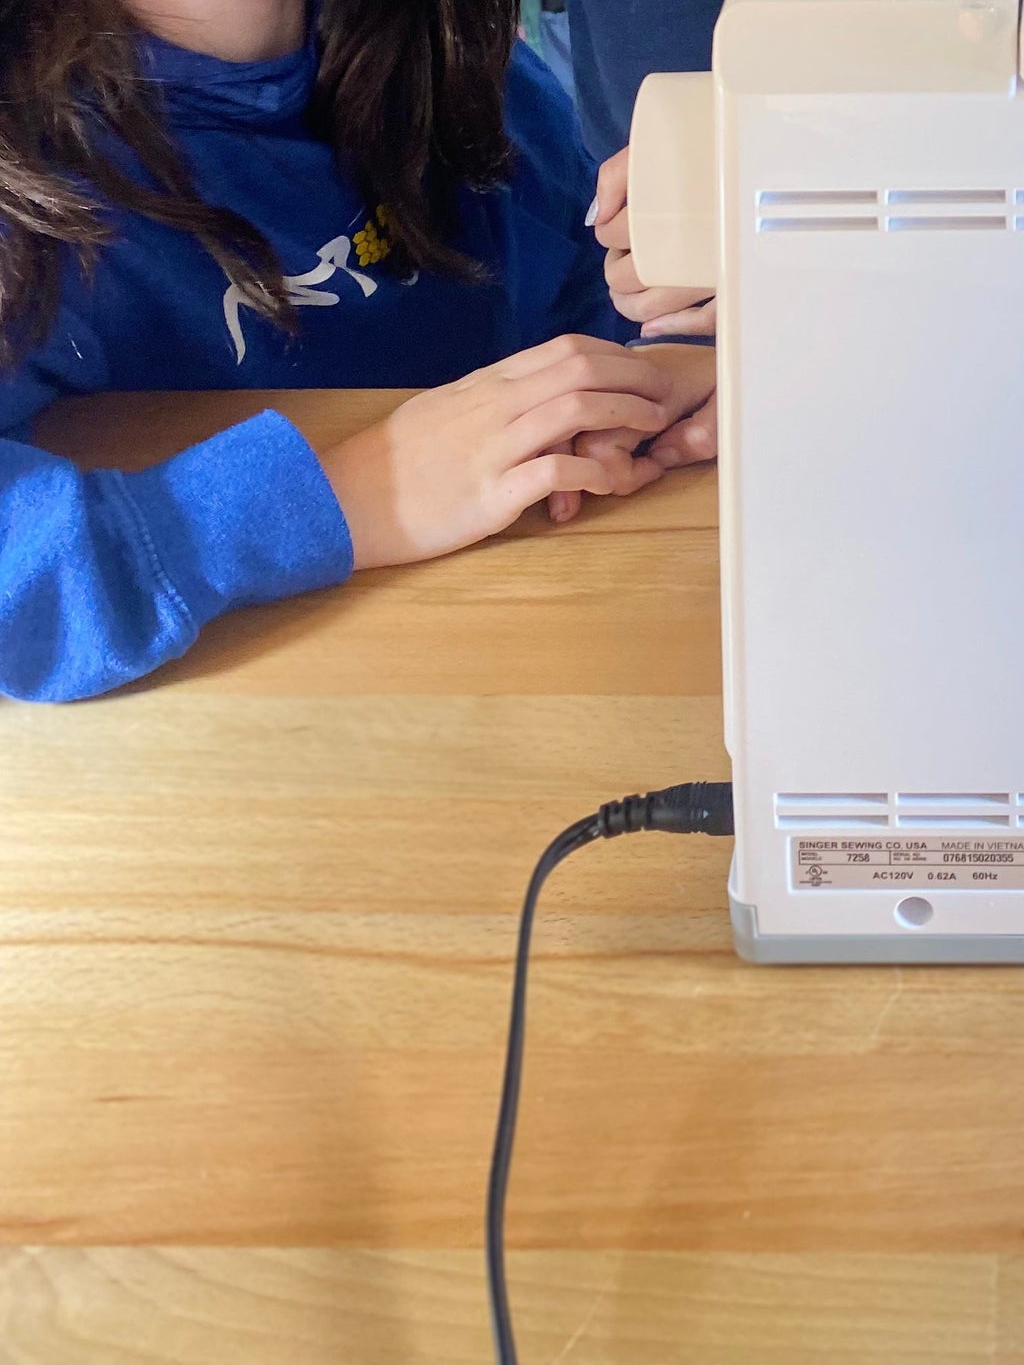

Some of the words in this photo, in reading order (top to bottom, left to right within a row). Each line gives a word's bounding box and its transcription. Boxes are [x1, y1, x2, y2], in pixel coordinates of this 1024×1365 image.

[799, 841, 838, 849] SINGER
[841, 841, 882, 849] SEWING
[905, 841, 927, 850] USA
[941, 841, 970, 850] MADE
[974, 841, 984, 850] IN
[846, 853, 870, 863] 7258
[872, 871, 914, 880] AC120V
[927, 872, 957, 881] 0.62A
[972, 872, 998, 880] 60Hz
